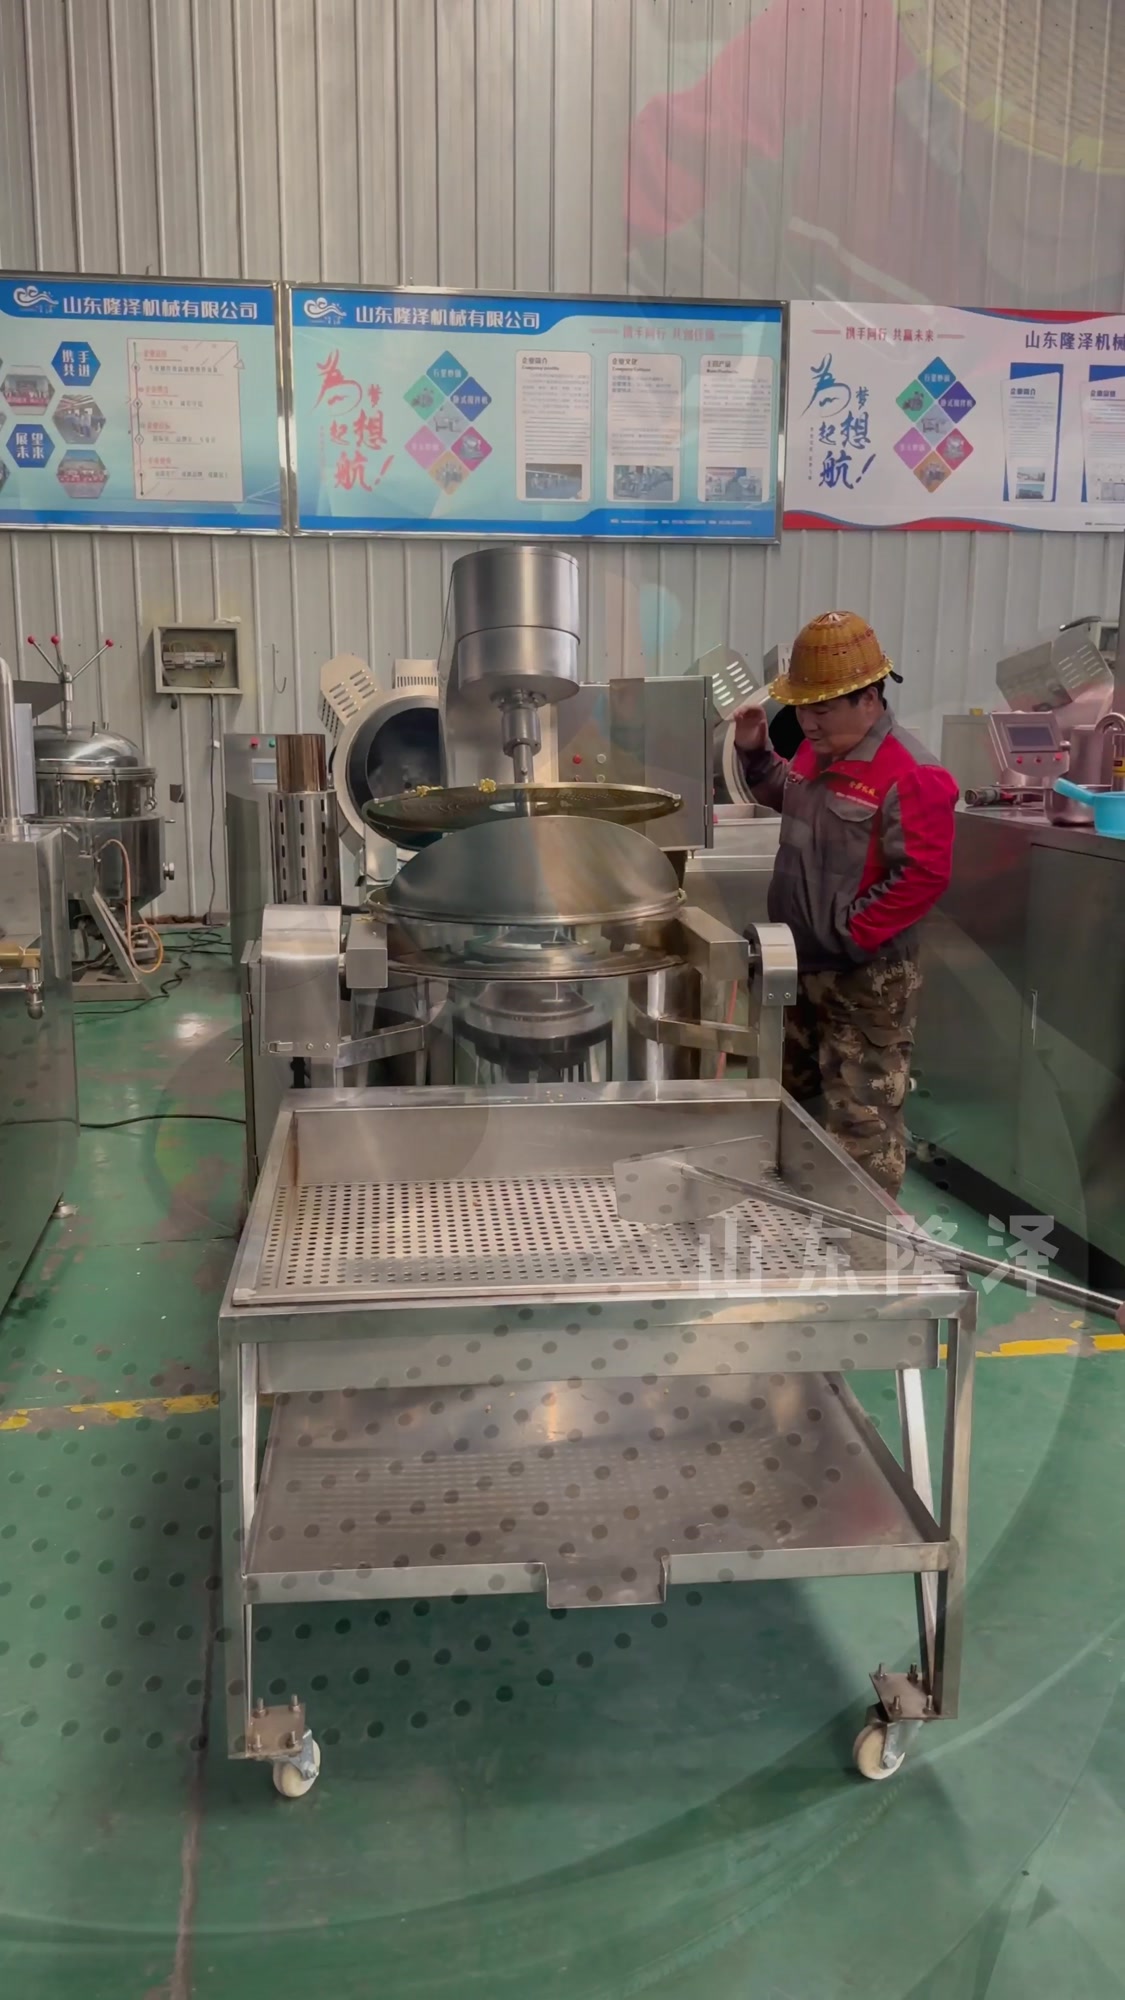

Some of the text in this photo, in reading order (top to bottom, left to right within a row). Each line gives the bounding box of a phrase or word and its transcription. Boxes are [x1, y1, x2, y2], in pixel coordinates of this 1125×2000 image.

[63, 296, 258, 319] 山东隆泽机械有限公司
[355, 305, 540, 330] 山东隆泽机械有限公司
[845, 326, 934, 342] 携手同行 共赢未来
[1025, 330, 1125, 351] 山东隆泽机械
[62, 349, 90, 363] 携手
[63, 363, 90, 377] 共进
[15, 432, 44, 446] 展望
[16, 445, 45, 459] 未来
